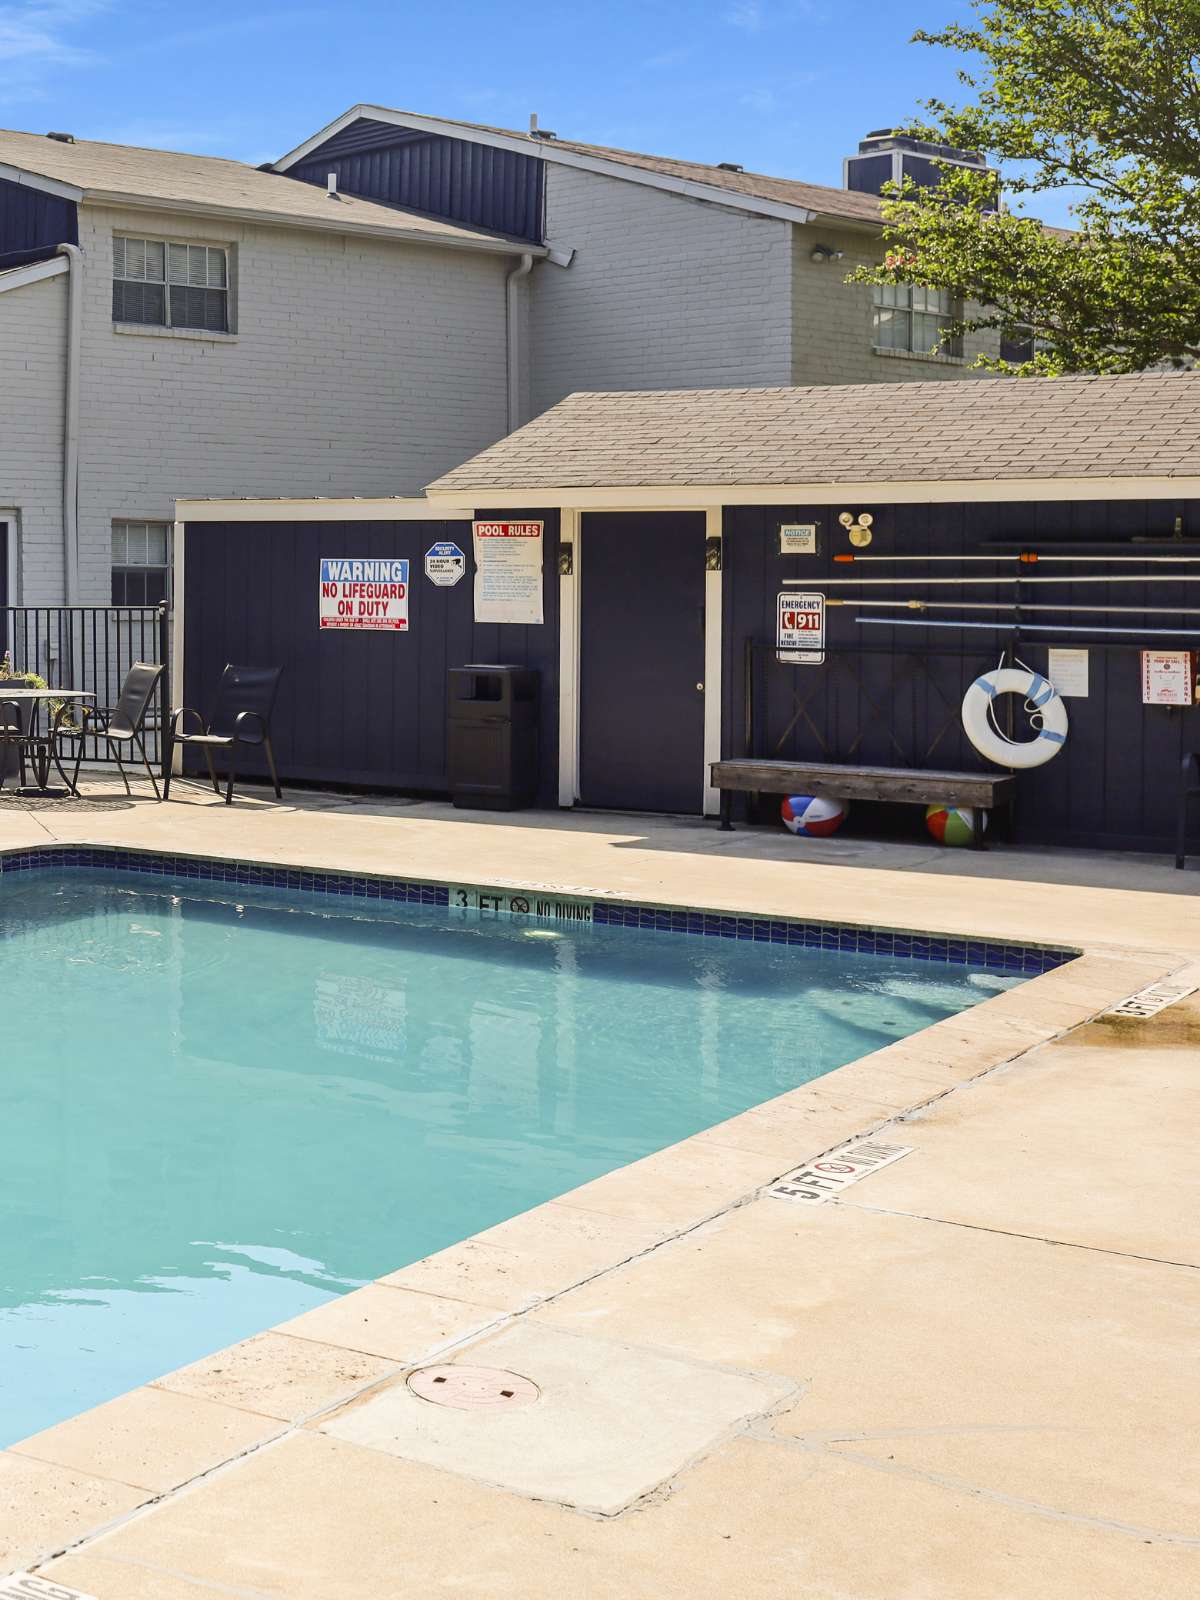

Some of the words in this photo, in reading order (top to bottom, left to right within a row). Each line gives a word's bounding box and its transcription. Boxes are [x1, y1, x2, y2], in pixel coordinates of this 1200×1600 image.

[478, 525, 505, 536] POOL
[508, 525, 539, 536] RULES
[785, 529, 810, 537] NOTICE
[327, 561, 403, 582] WARNING
[322, 582, 338, 598] NO
[342, 583, 406, 599] LIFEGUARD
[337, 600, 353, 615] ON
[358, 600, 390, 616] DUTY
[781, 600, 821, 610] EMERGENCY
[797, 612, 820, 629] 911
[456, 889, 468, 908] 3
[479, 895, 504, 912] FT
[536, 900, 551, 917] NO
[555, 903, 592, 922] DIVING
[792, 1171, 845, 1190] FT
[773, 1186, 821, 1200] 5
